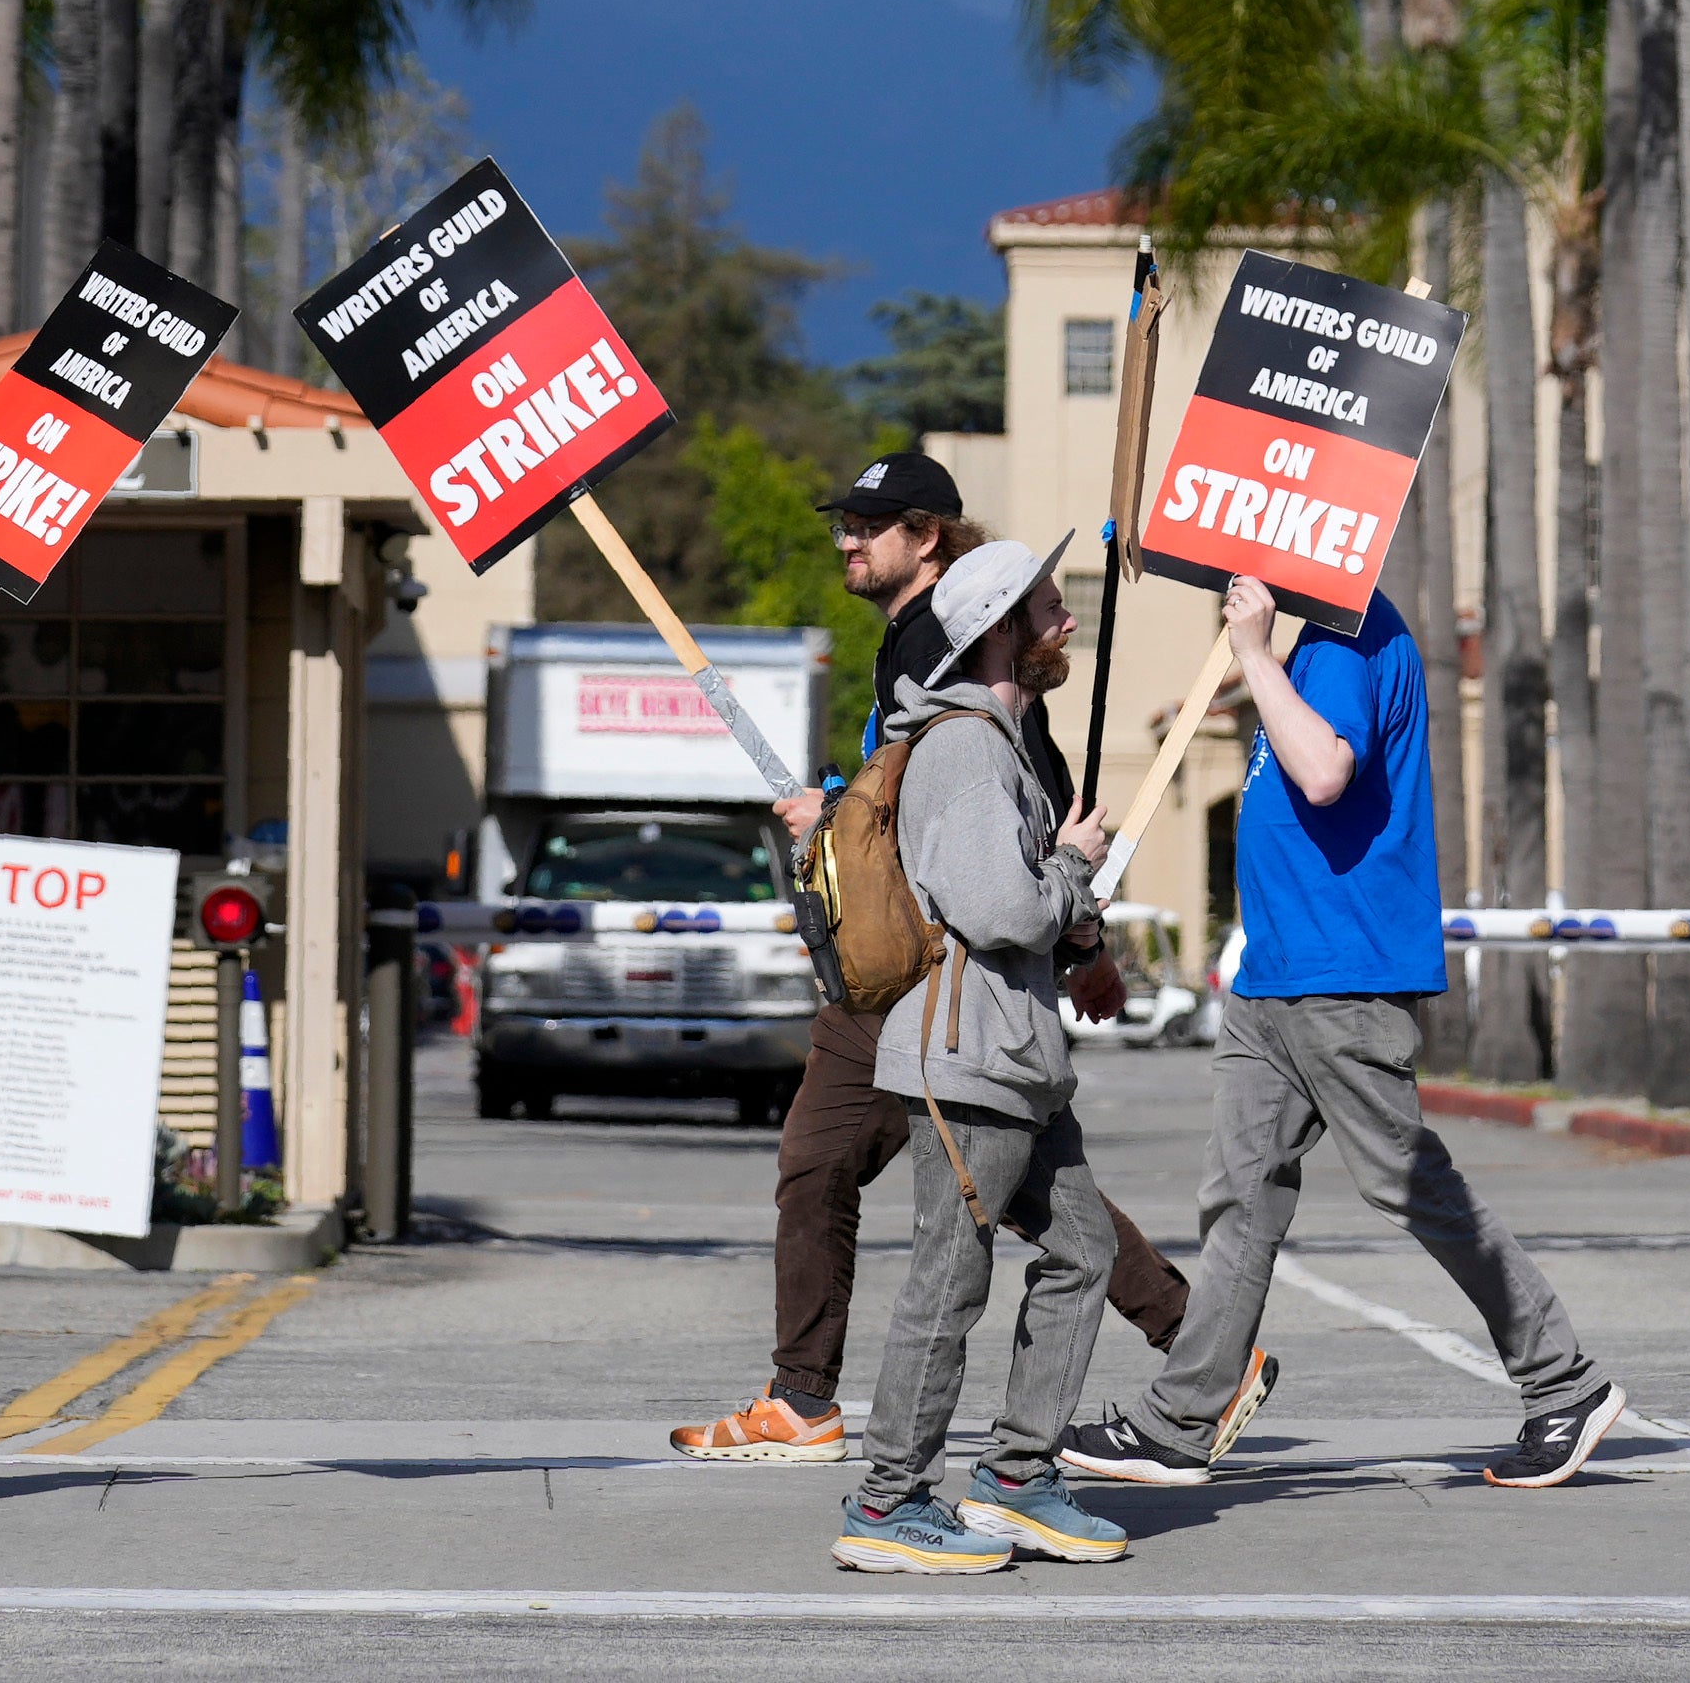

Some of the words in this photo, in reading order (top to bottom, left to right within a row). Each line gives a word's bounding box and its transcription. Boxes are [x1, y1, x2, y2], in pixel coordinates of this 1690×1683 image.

[318, 243, 433, 344] WRITERS
[429, 188, 508, 260] GUILD
[419, 277, 451, 313] OF
[78, 271, 157, 329] WRITERS
[148, 310, 207, 357] GUILD
[102, 331, 130, 356] OF
[401, 278, 519, 381] AMERICA
[1240, 284, 1355, 342] WRITERS
[1357, 317, 1438, 366] GUILD
[49, 348, 133, 410] AMERICA
[471, 352, 527, 409] ON
[1307, 346, 1340, 373] OF
[1249, 367, 1369, 426] AMERICA
[26, 412, 70, 454] ON
[429, 337, 639, 527] STRIKE!
[1263, 438, 1315, 480] ON
[1163, 464, 1380, 575] STRIKE!
[895, 1525, 944, 1546] HOKA
